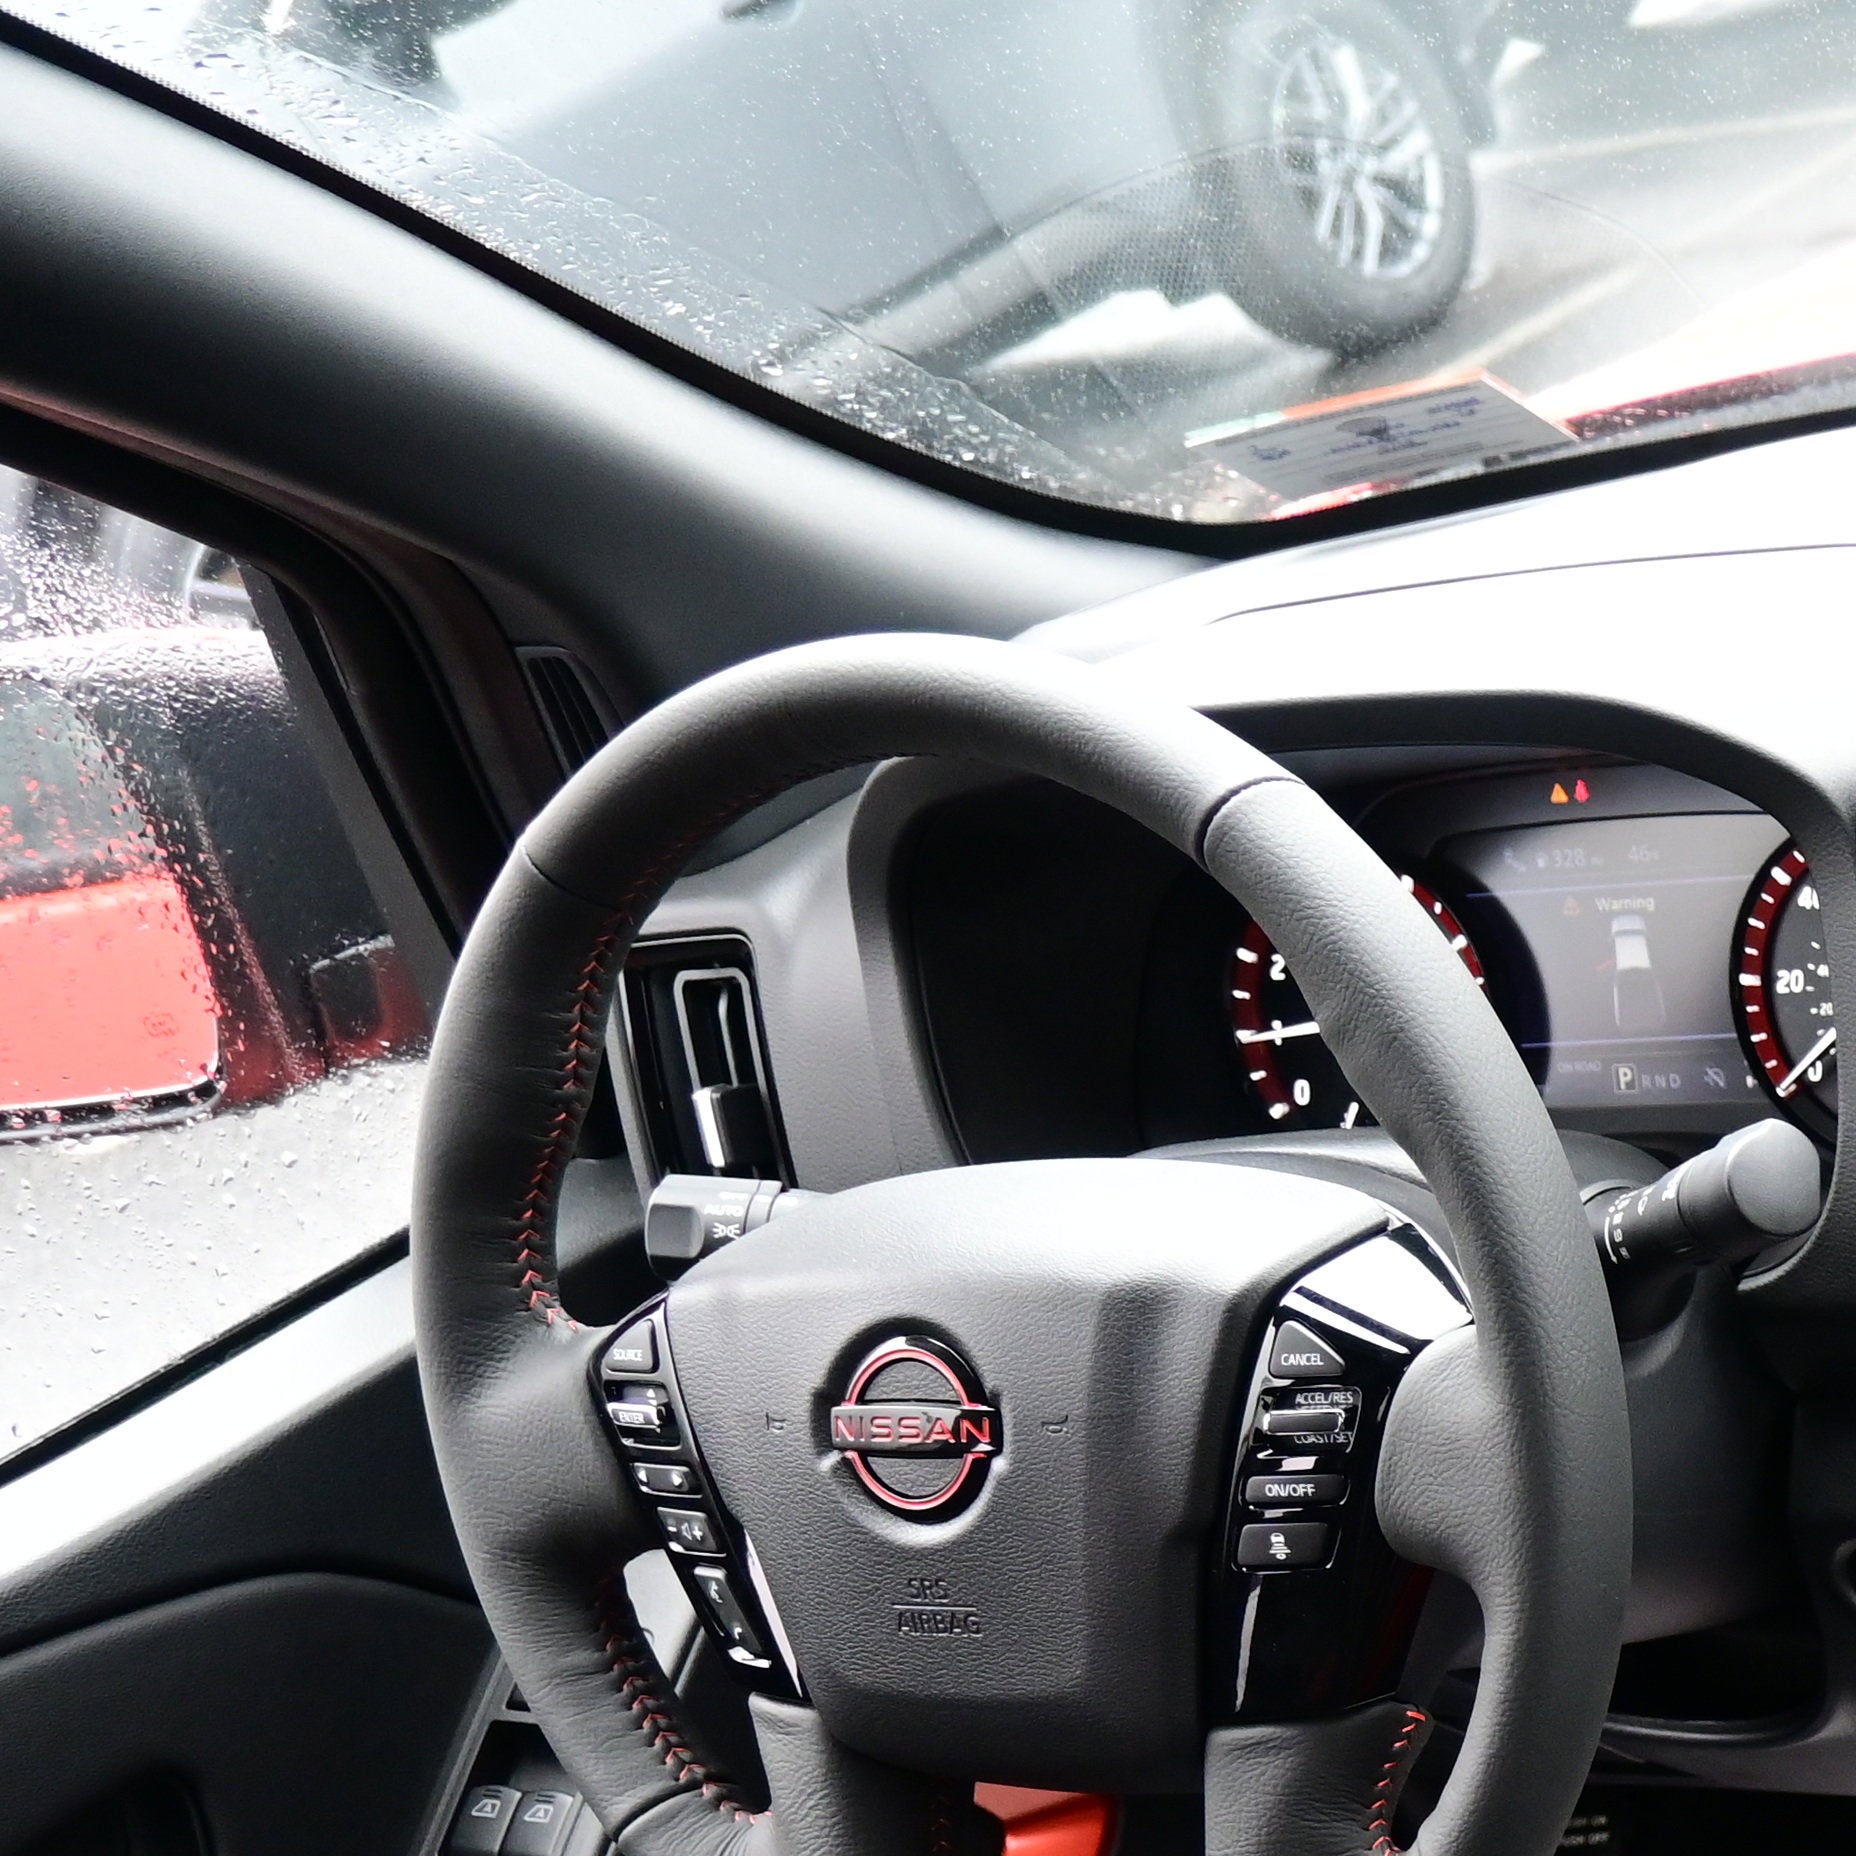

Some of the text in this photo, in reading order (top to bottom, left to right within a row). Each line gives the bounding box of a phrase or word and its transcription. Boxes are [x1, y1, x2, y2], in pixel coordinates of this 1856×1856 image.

[1595, 897, 1655, 910] Warning
[1776, 969, 1804, 994] 20
[1281, 1354, 1324, 1366] CANCEL
[1295, 1392, 1353, 1404] ACCEL/RES
[834, 1416, 991, 1444] NISSAN
[1265, 1484, 1315, 1496] ON/OFF
[907, 1578, 949, 1600] SRS
[898, 1612, 981, 1635] AIRBAG
